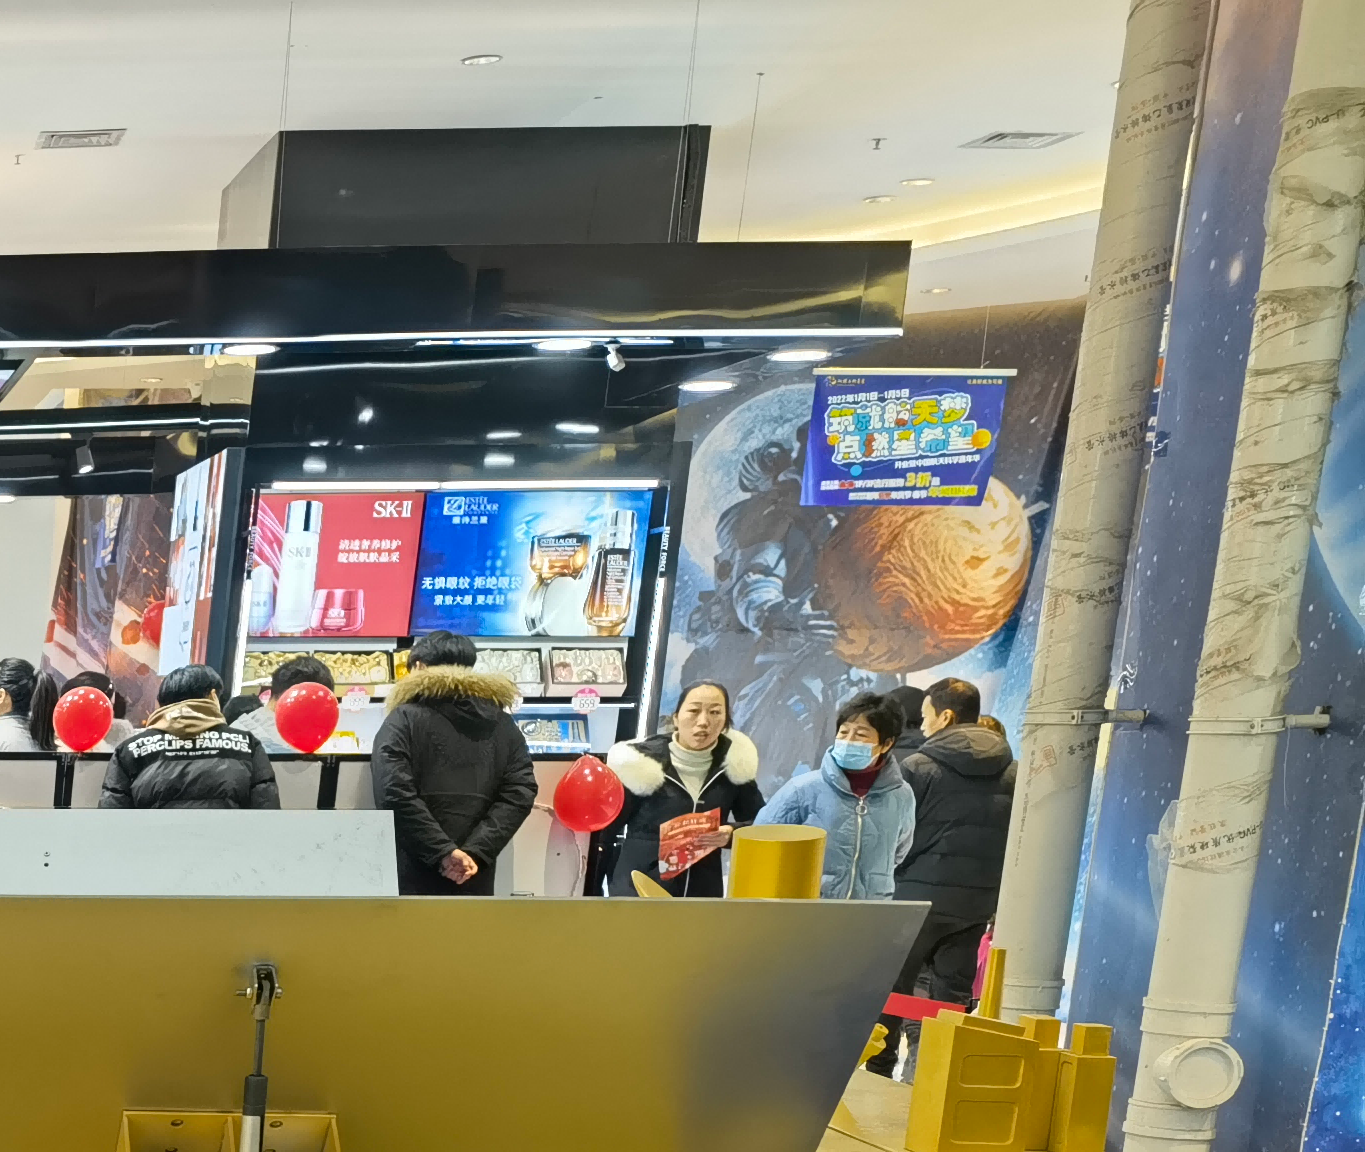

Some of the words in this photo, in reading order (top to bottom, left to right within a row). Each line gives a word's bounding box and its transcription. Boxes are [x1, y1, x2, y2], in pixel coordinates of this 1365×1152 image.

[836, 423, 973, 460] 点燃星希望
[372, 500, 413, 518] SK-II
[127, 735, 162, 751] STOP
[133, 739, 193, 758] PERCLIPS
